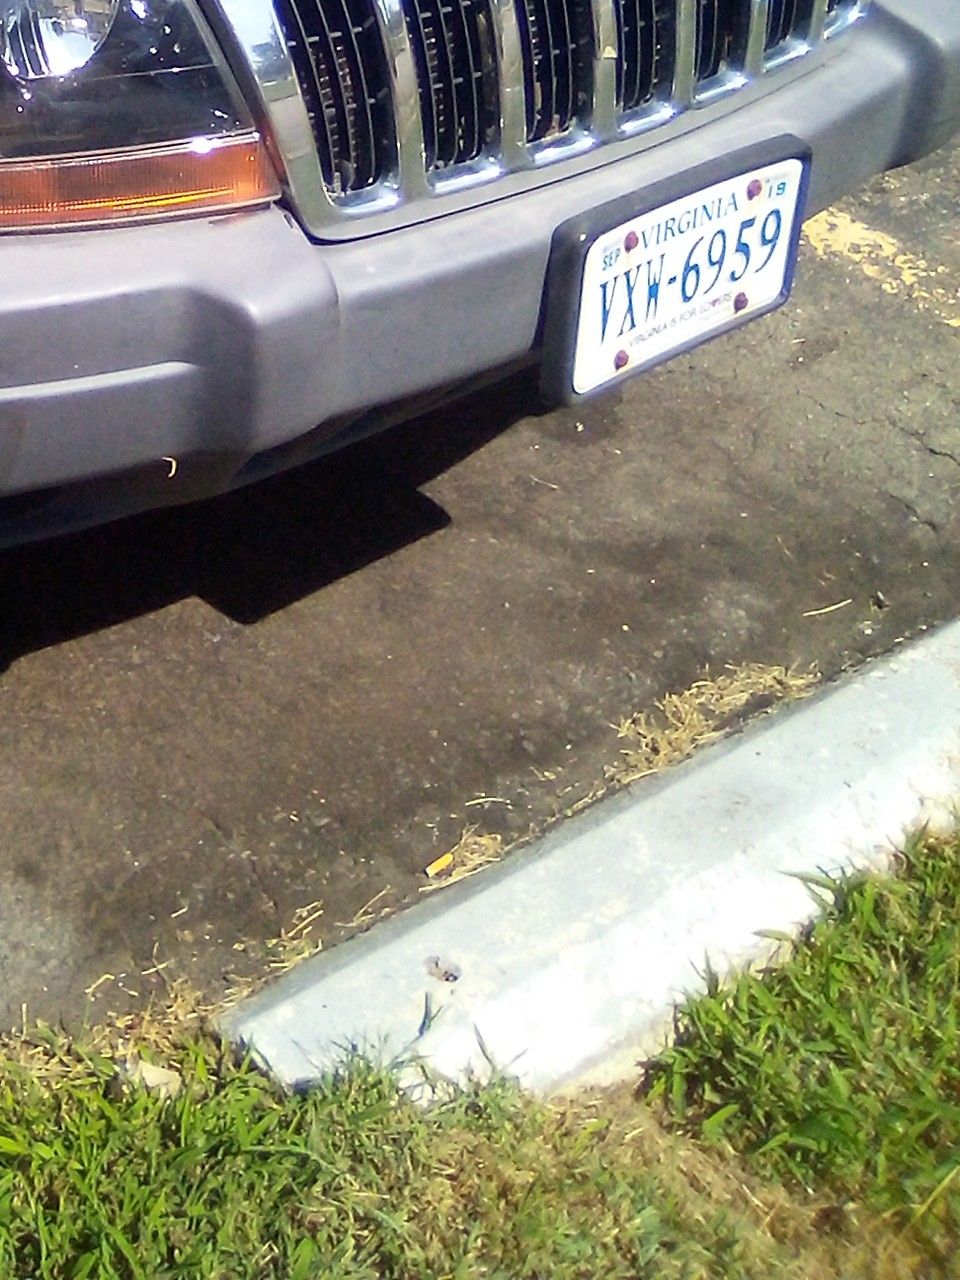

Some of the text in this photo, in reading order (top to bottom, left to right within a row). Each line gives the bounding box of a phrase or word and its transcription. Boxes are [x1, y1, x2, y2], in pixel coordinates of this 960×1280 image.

[767, 181, 787, 199] 19
[641, 192, 739, 249] VIRGINIA
[599, 207, 782, 345] VXW-6959
[602, 247, 621, 271] SEP
